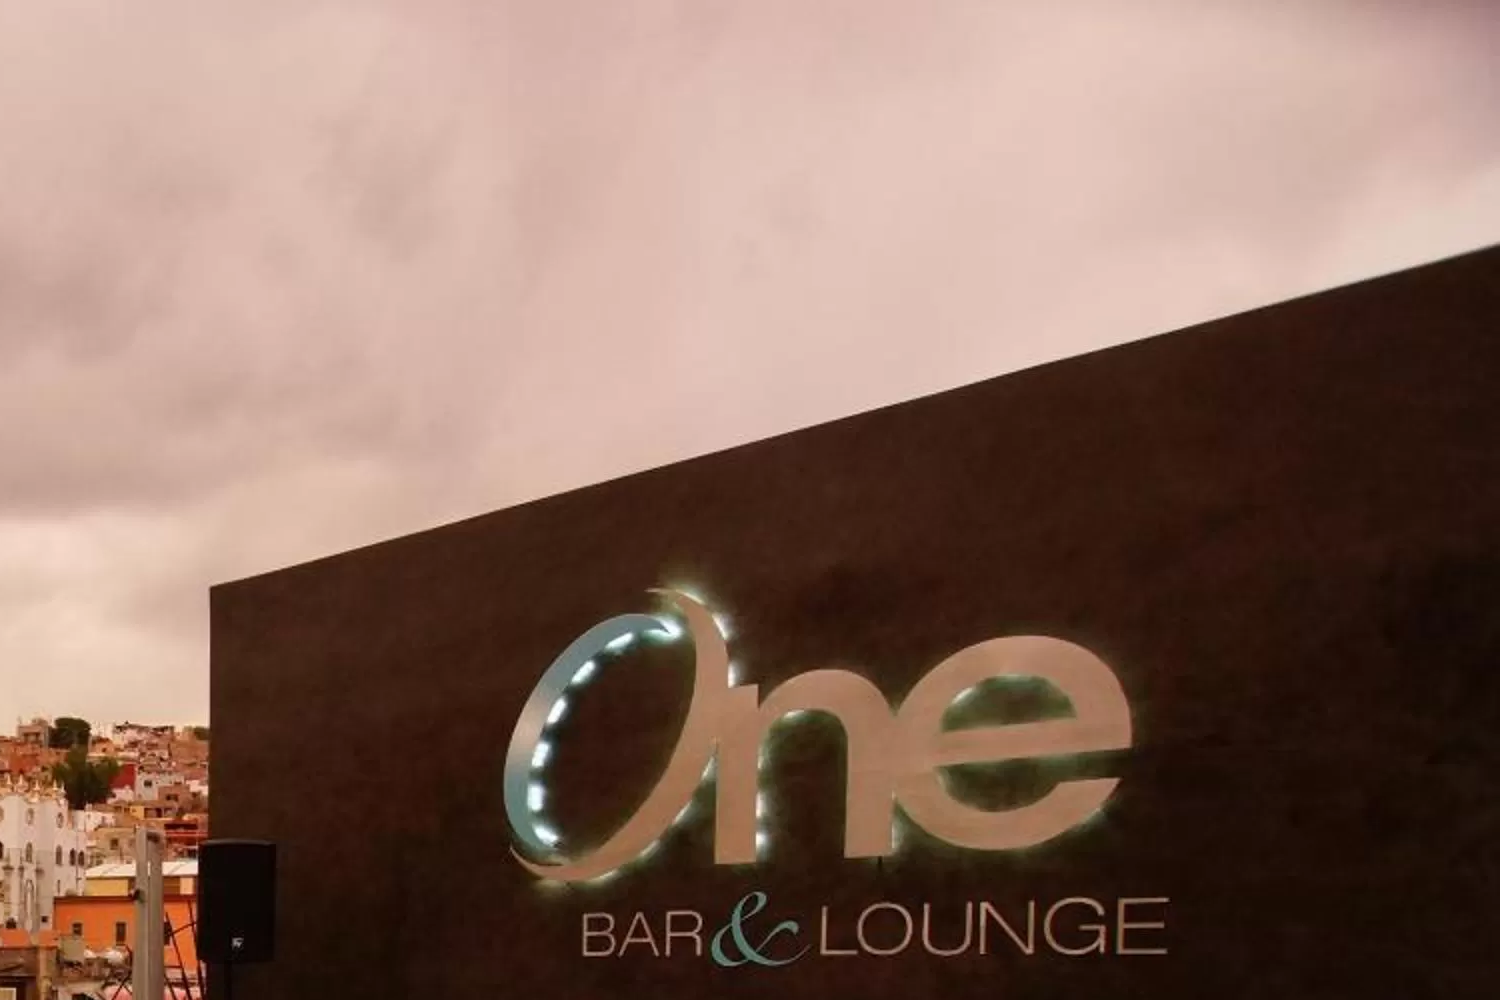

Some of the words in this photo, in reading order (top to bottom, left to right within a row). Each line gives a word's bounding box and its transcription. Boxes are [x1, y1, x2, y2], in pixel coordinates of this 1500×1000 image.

[503, 587, 1132, 881] One
[581, 911, 703, 958] BAR
[710, 891, 812, 967] &
[819, 897, 1170, 956] LOUNGE
